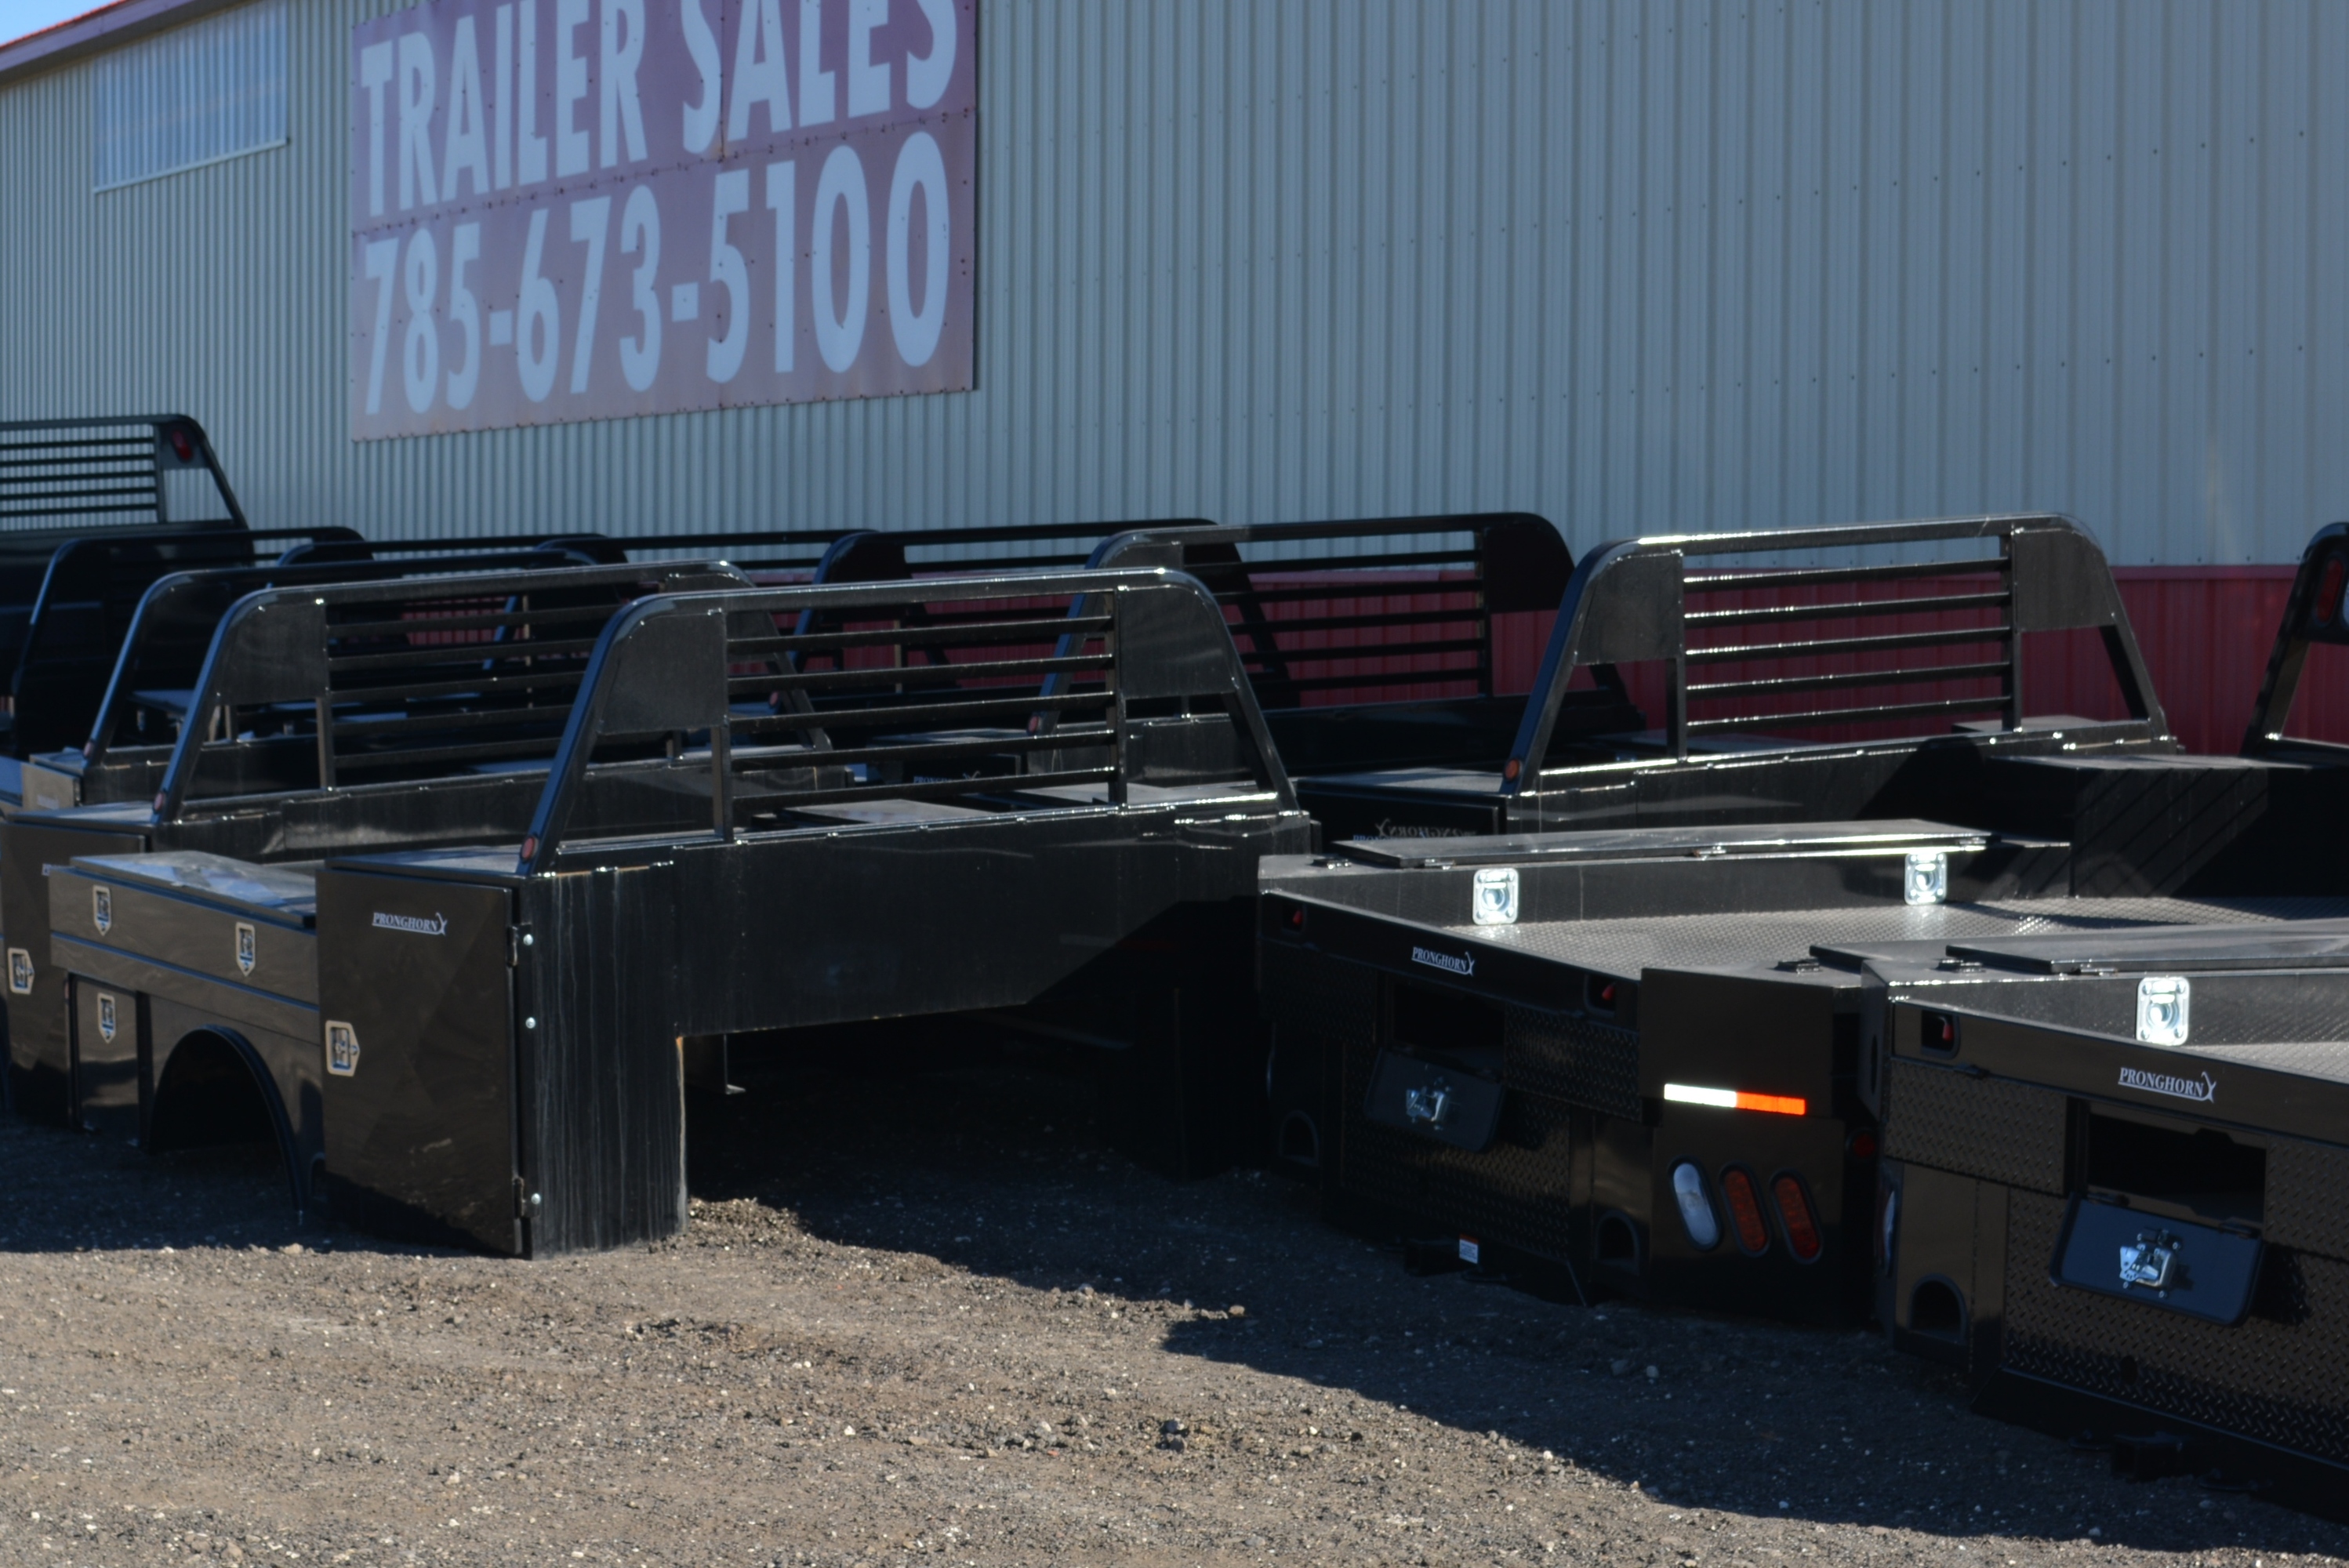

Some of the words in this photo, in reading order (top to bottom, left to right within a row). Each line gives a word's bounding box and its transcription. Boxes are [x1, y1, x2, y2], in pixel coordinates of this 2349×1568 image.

[361, 0, 648, 218] TRAILER
[365, 131, 950, 416] 785-673-5100
[372, 912, 439, 933] PRONGHORN
[1412, 946, 1468, 972] PRONGHORN
[2118, 1067, 2205, 1098] PRONGHORN
